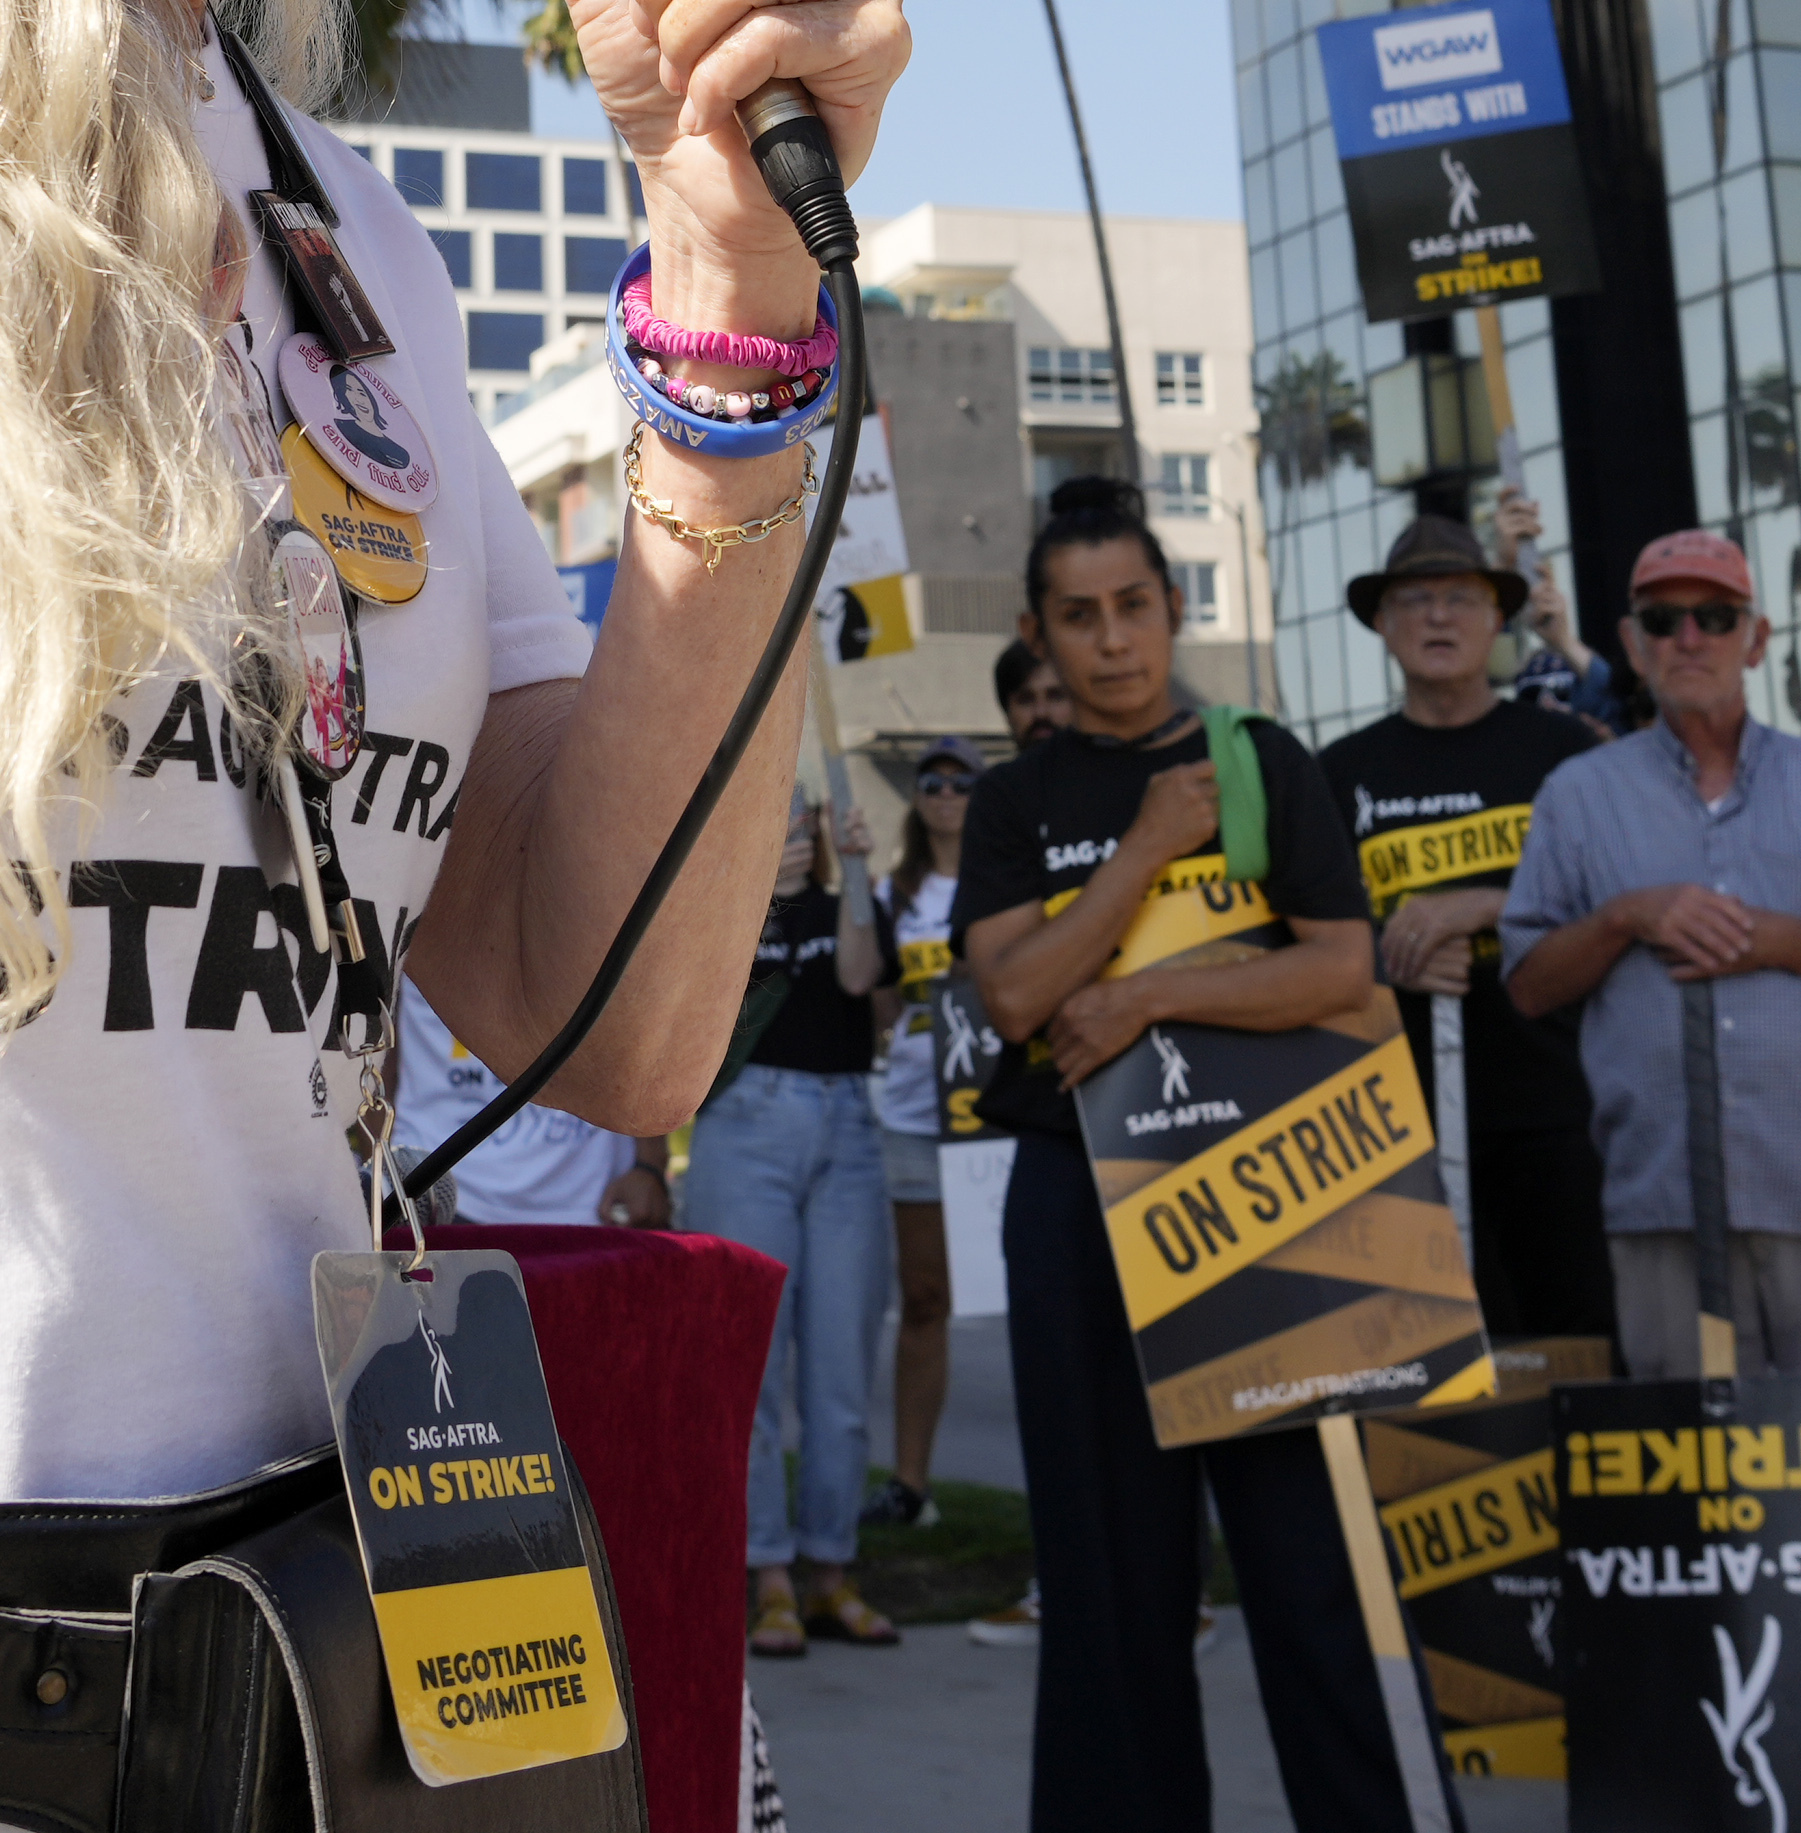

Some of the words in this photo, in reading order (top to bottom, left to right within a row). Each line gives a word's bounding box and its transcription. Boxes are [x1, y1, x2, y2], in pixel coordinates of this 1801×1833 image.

[1383, 31, 1489, 68] WGAW
[1371, 92, 1462, 139] STANDS
[1464, 82, 1528, 122] WITH
[1415, 257, 1543, 301] STRIKE!
[323, 424, 361, 467] and
[367, 462, 406, 493] find
[329, 532, 356, 553] ON
[358, 537, 415, 564] STRIKE
[1370, 842, 1412, 884] ON
[1143, 1178, 1238, 1275] ON
[1231, 1073, 1414, 1224] STRIKE
[368, 1467, 425, 1511] ON
[429, 1453, 556, 1506] STRIKE!
[1698, 1496, 1765, 1532] ON
[417, 1633, 587, 1691] NEGOTIATING
[438, 1674, 587, 1730] COMMITTEE
